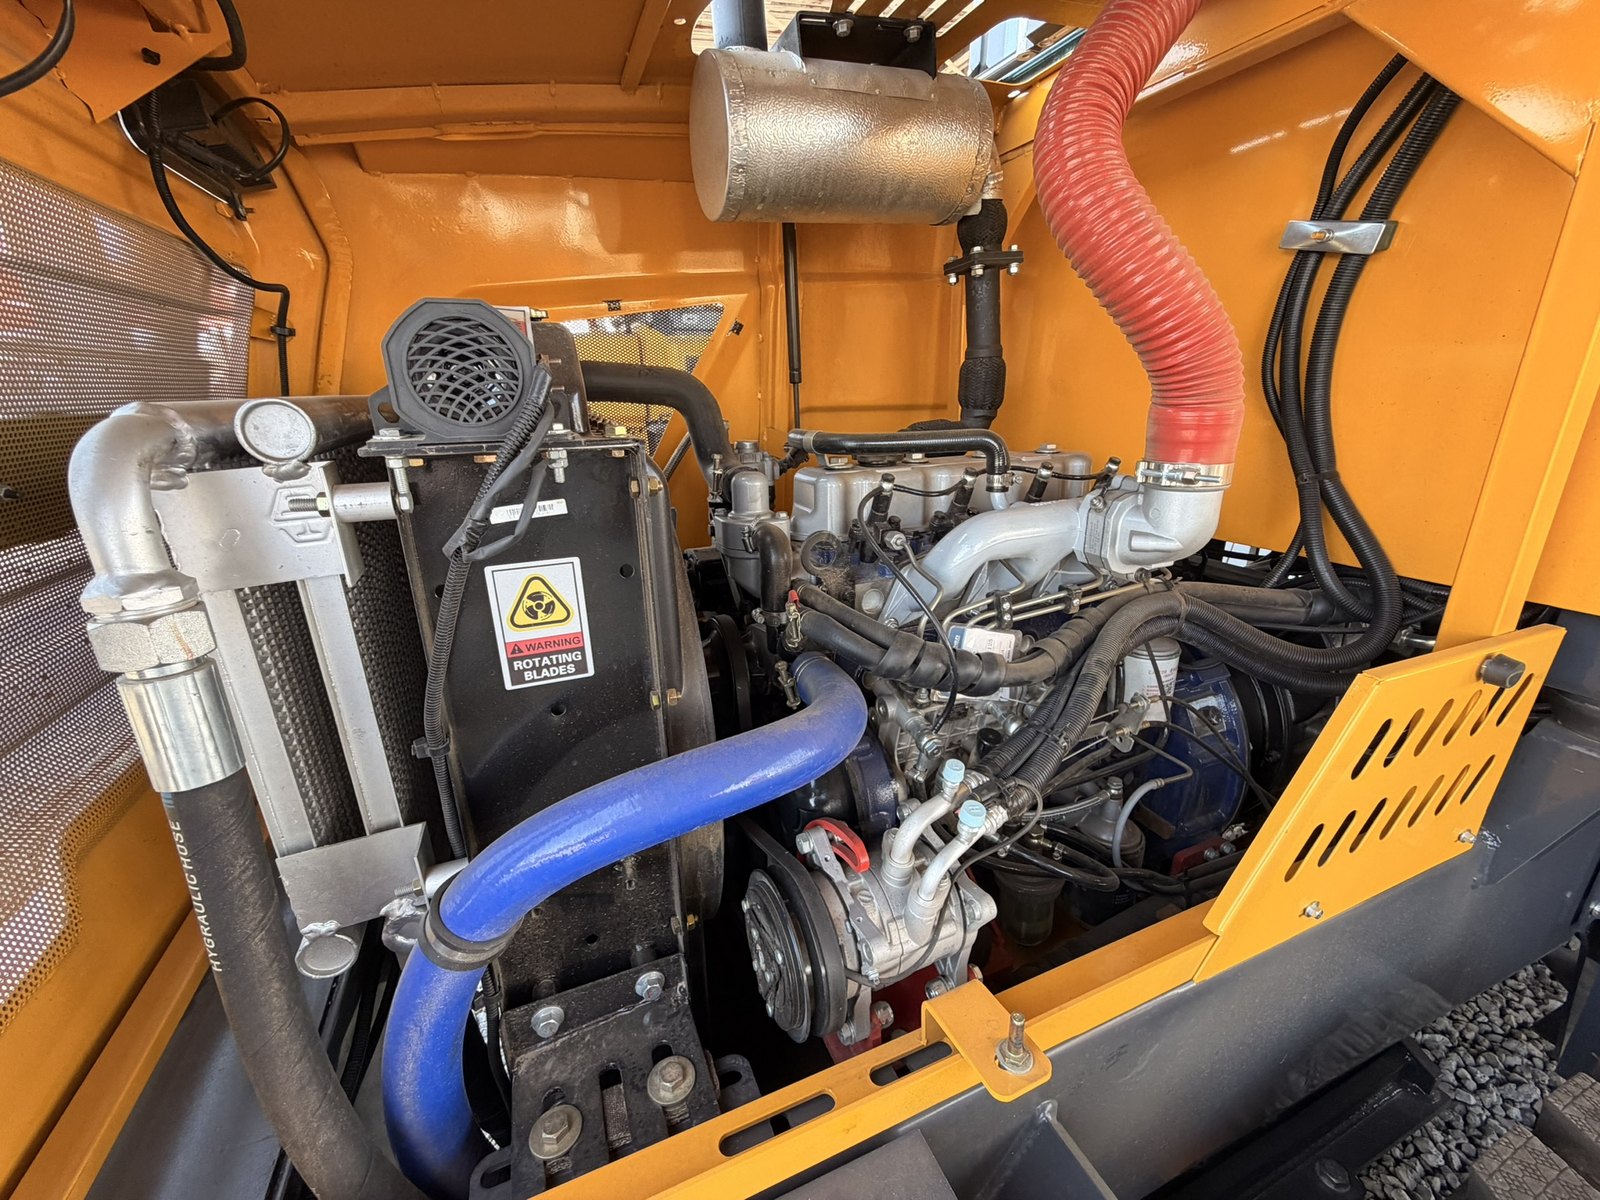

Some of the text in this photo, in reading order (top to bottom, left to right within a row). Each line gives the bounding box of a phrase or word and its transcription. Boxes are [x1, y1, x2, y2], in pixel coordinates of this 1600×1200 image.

[525, 636, 581, 652] WARNING
[513, 651, 582, 671] ROTATING
[523, 664, 576, 681] BLADES
[170, 821, 194, 870] HOSE
